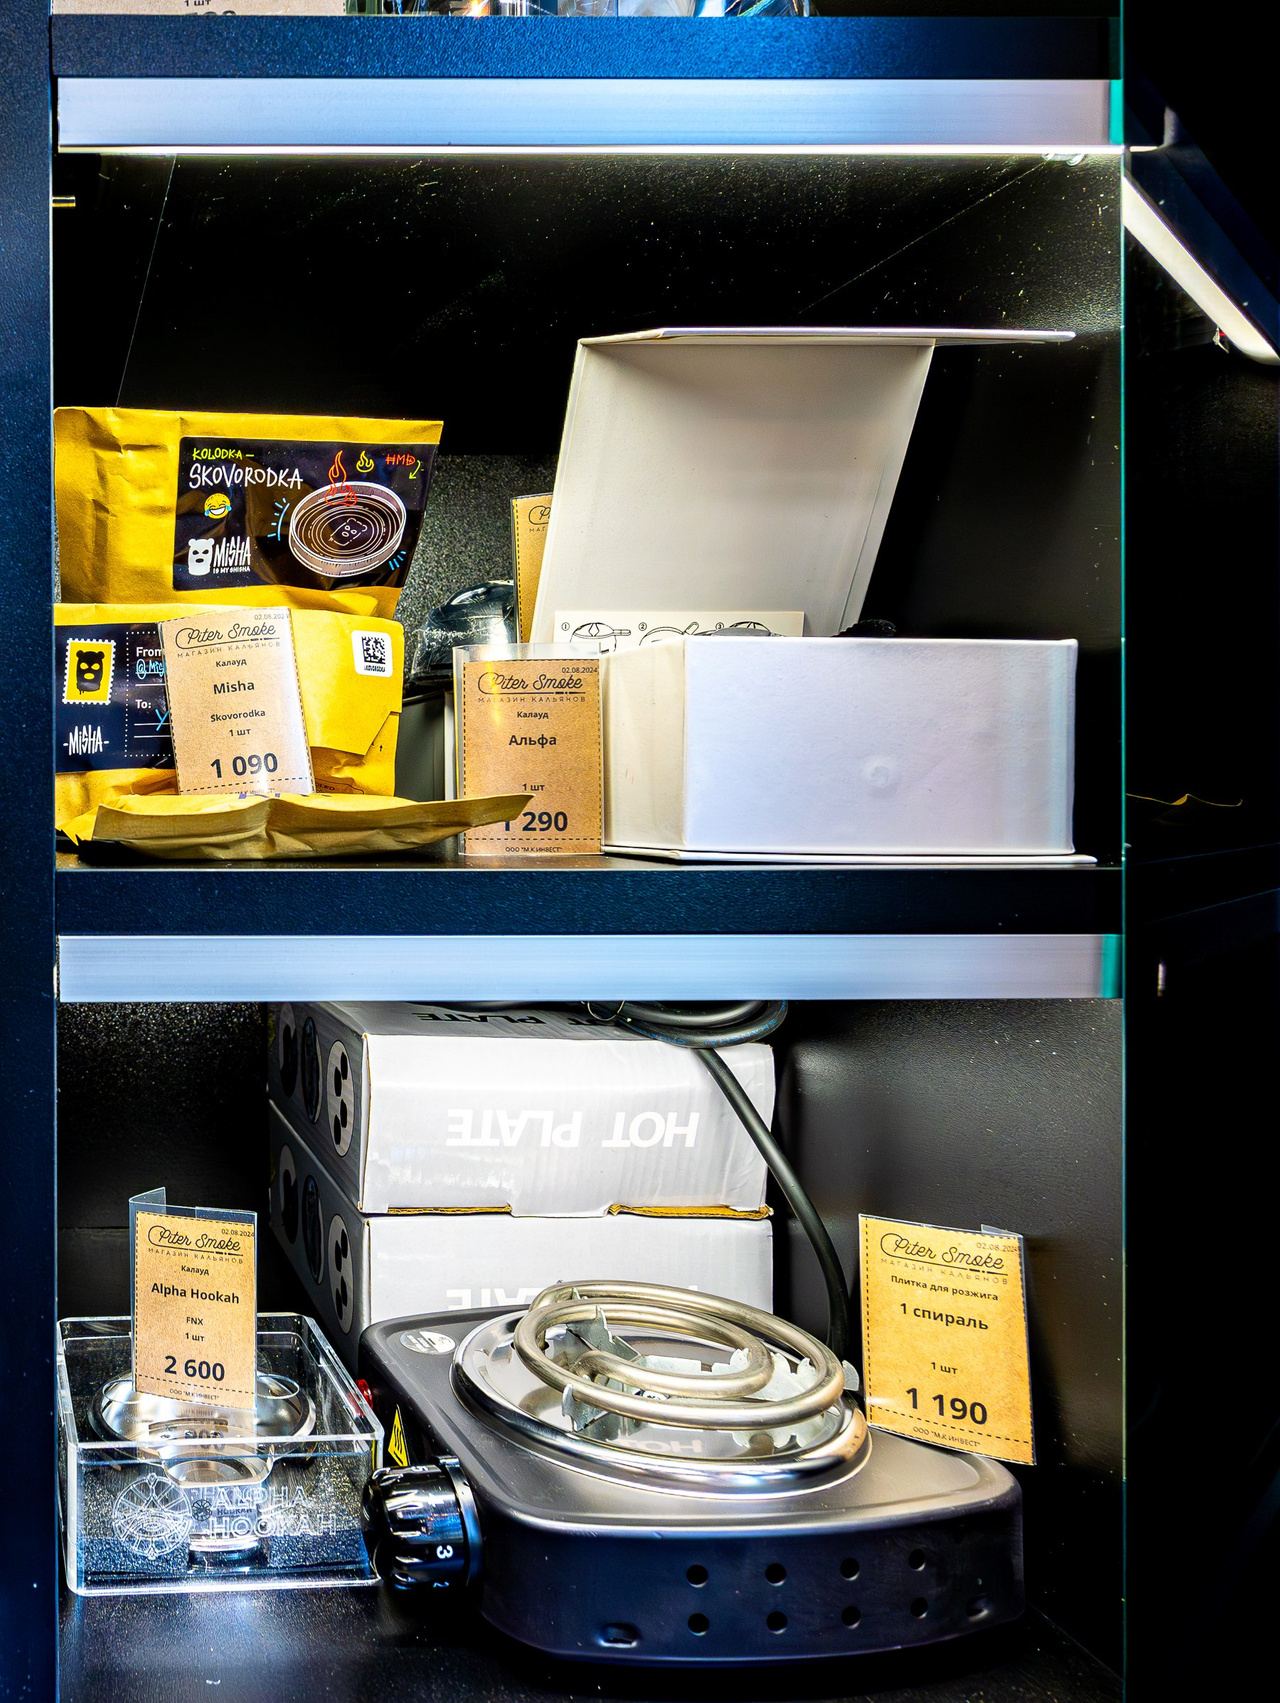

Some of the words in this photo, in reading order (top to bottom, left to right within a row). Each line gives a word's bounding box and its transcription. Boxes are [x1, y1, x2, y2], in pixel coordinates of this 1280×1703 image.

[193, 448, 243, 461] KOLODKA
[189, 462, 303, 490] SKOVORODKA
[227, 622, 276, 638] Smoke
[177, 647, 222, 659] МАГАЗИН
[228, 641, 280, 652] КАЛЬЯНОВ
[216, 658, 247, 667] Калауд
[214, 680, 255, 695] Misha
[533, 673, 583, 690] Smoke
[135, 700, 151, 708] To:
[210, 709, 266, 723] Skovorodka
[517, 711, 549, 720] Калауд
[229, 729, 234, 737] 1
[509, 734, 557, 748] Альфа
[210, 759, 222, 779] 1
[232, 753, 278, 777] 090
[523, 783, 527, 791] 1
[530, 784, 545, 792] шт
[522, 812, 568, 831] 290
[446, 1109, 583, 1147] PLATE
[602, 1111, 700, 1148] HOT
[195, 1233, 241, 1251] Smoke
[148, 1248, 189, 1258] МАГАЗИН
[194, 1254, 244, 1264] КАЛЬЯНОВ
[942, 1246, 1004, 1270] Smoke
[181, 1265, 209, 1276] Калауд
[881, 1259, 933, 1274] МАГАЗИН
[941, 1270, 1008, 1285] КАЛЬЯНОВ
[151, 1283, 187, 1298] Alpha
[191, 1289, 239, 1304] Hookah
[891, 1275, 928, 1289] Плитка
[930, 1283, 949, 1294] для
[952, 1285, 998, 1301] розжига
[186, 1317, 203, 1326] FNX
[900, 1303, 908, 1314] 1
[913, 1306, 989, 1330] спираль
[185, 1332, 189, 1340] 1
[192, 1334, 205, 1342] шт
[164, 1355, 177, 1374] 2
[184, 1359, 225, 1381] 600
[931, 1361, 936, 1370] 1
[940, 1365, 958, 1375] шт
[906, 1387, 919, 1410] 1
[932, 1394, 988, 1425] 190
[437, 1545, 453, 1559] 3
